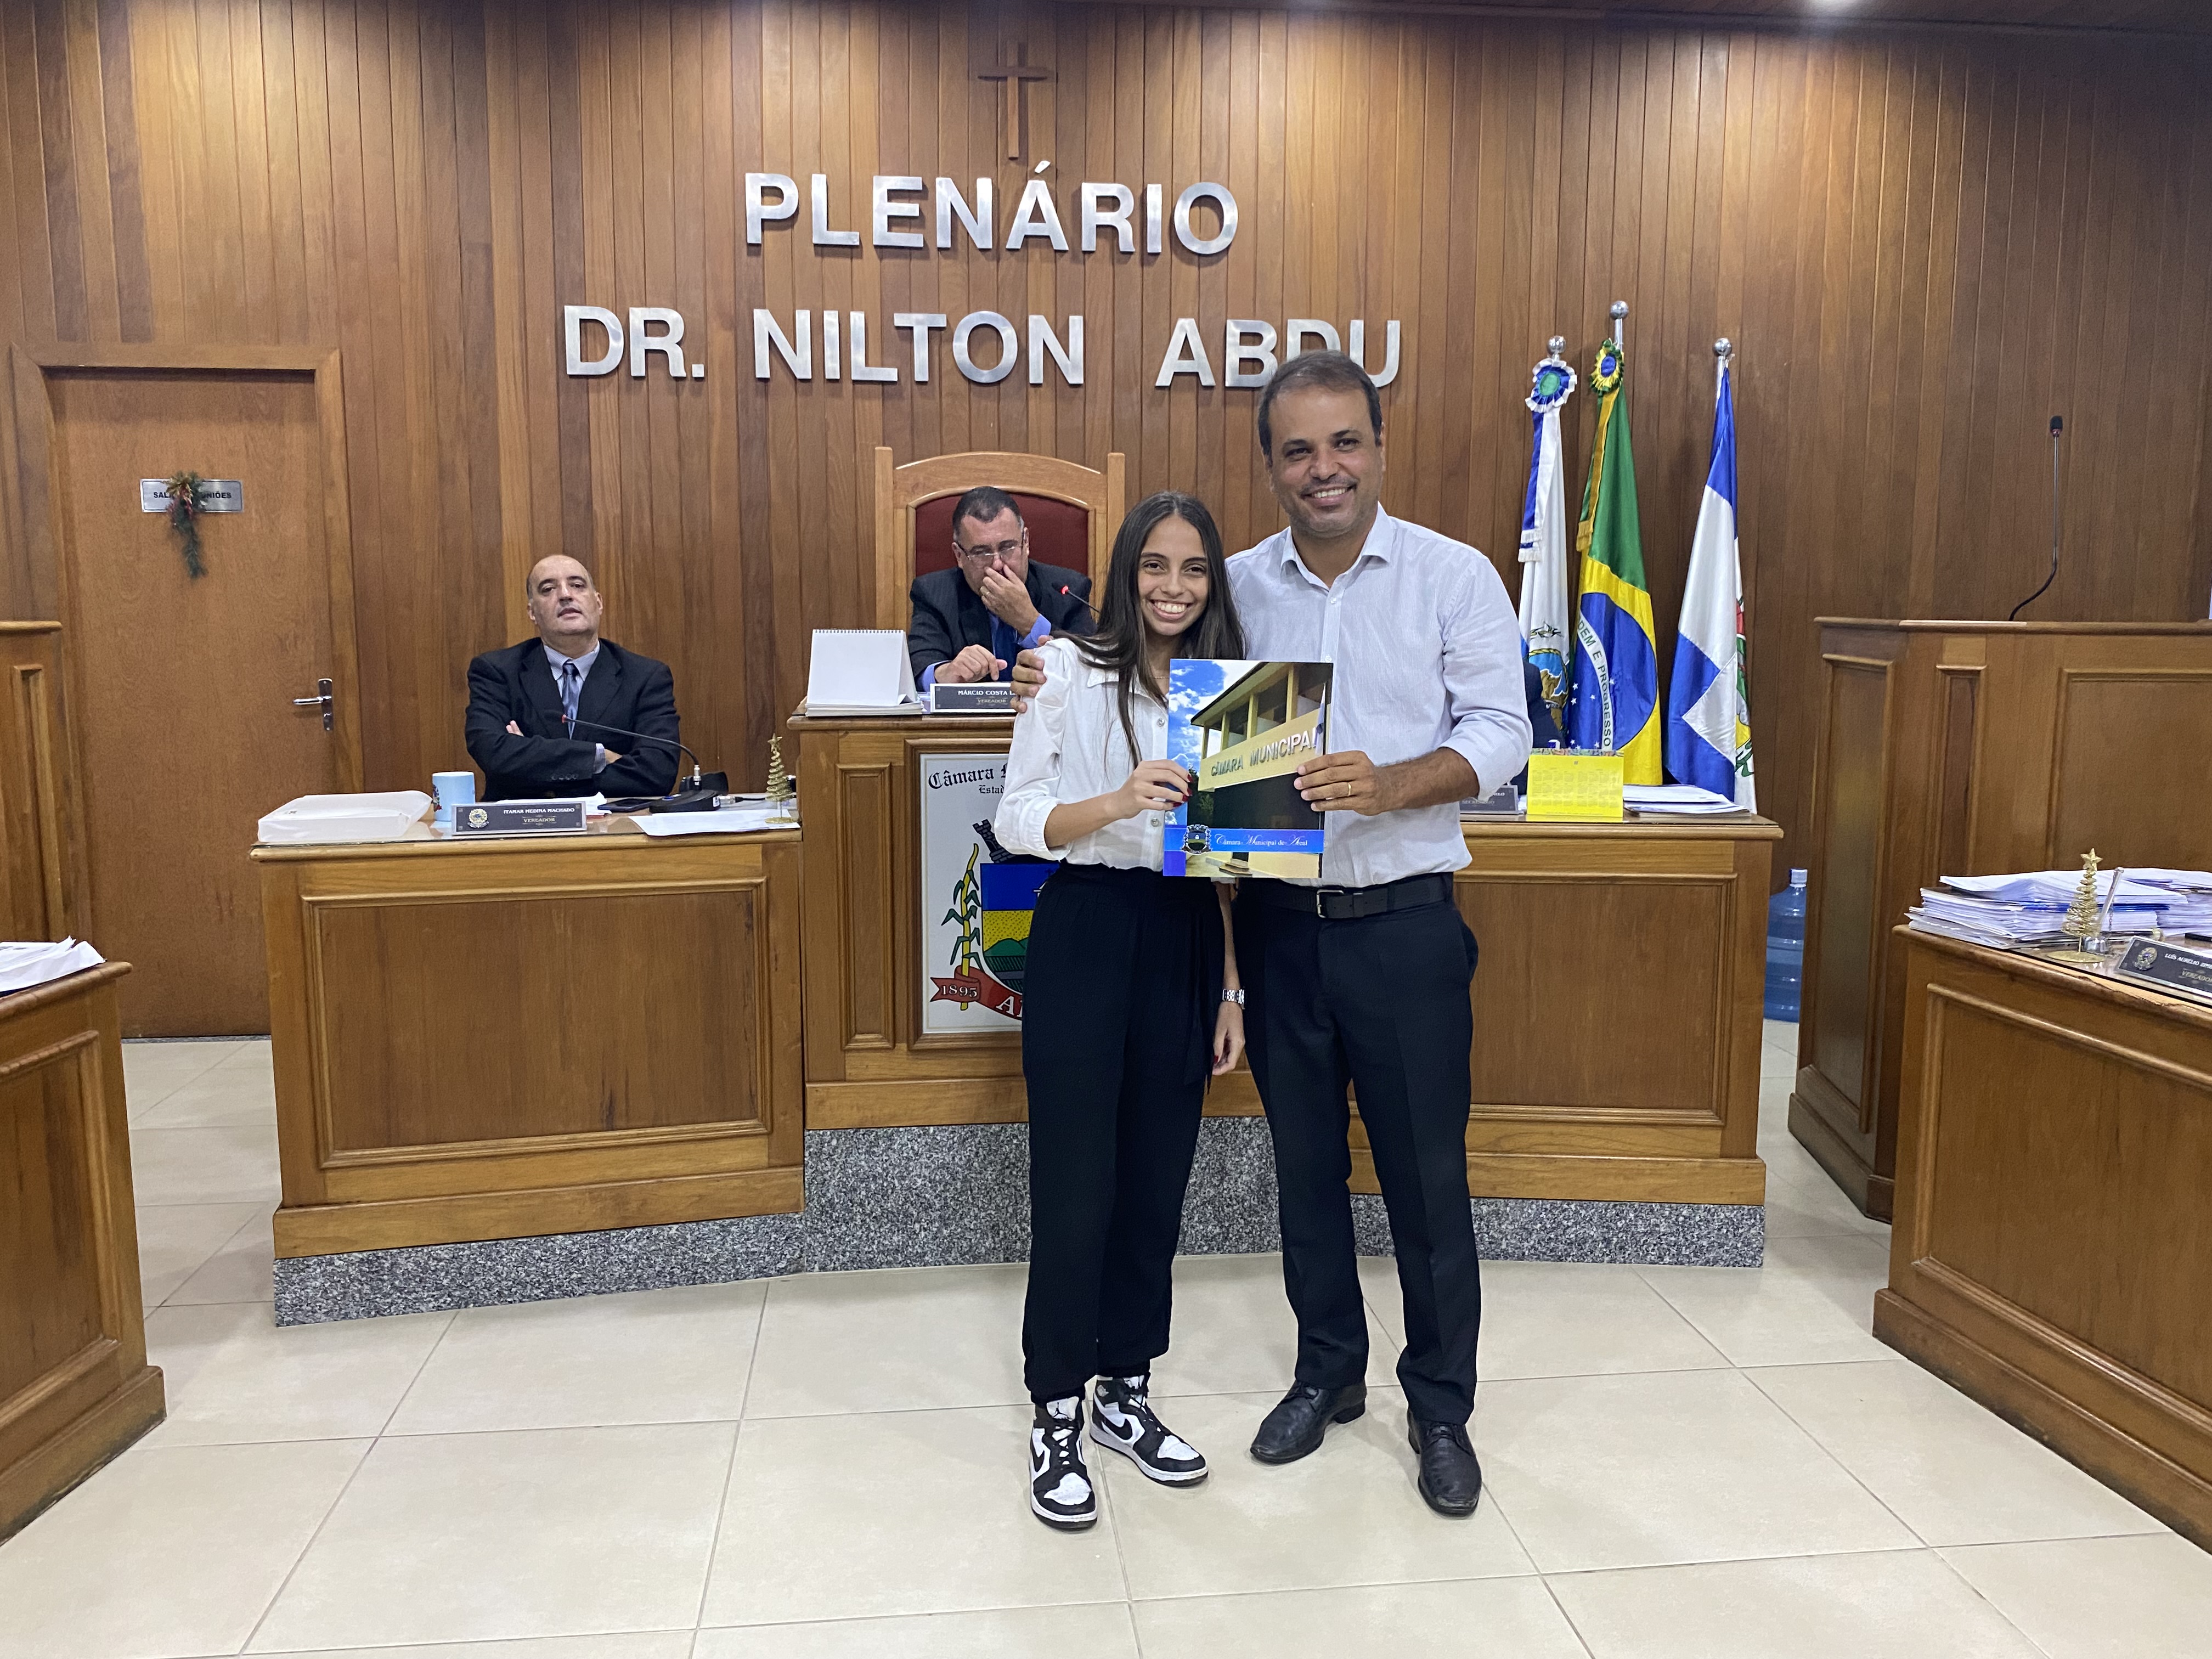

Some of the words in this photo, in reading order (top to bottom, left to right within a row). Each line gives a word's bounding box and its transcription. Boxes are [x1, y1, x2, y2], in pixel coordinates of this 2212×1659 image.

[745, 160, 1238, 255] PLENÁRIO
[564, 305, 705, 378] DR.
[753, 308, 1084, 385] NILTON
[1592, 650, 1603, 661] E
[1598, 665, 1612, 747] PROGRESSO
[928, 769, 994, 789] Câmara
[942, 984, 978, 998] 1895
